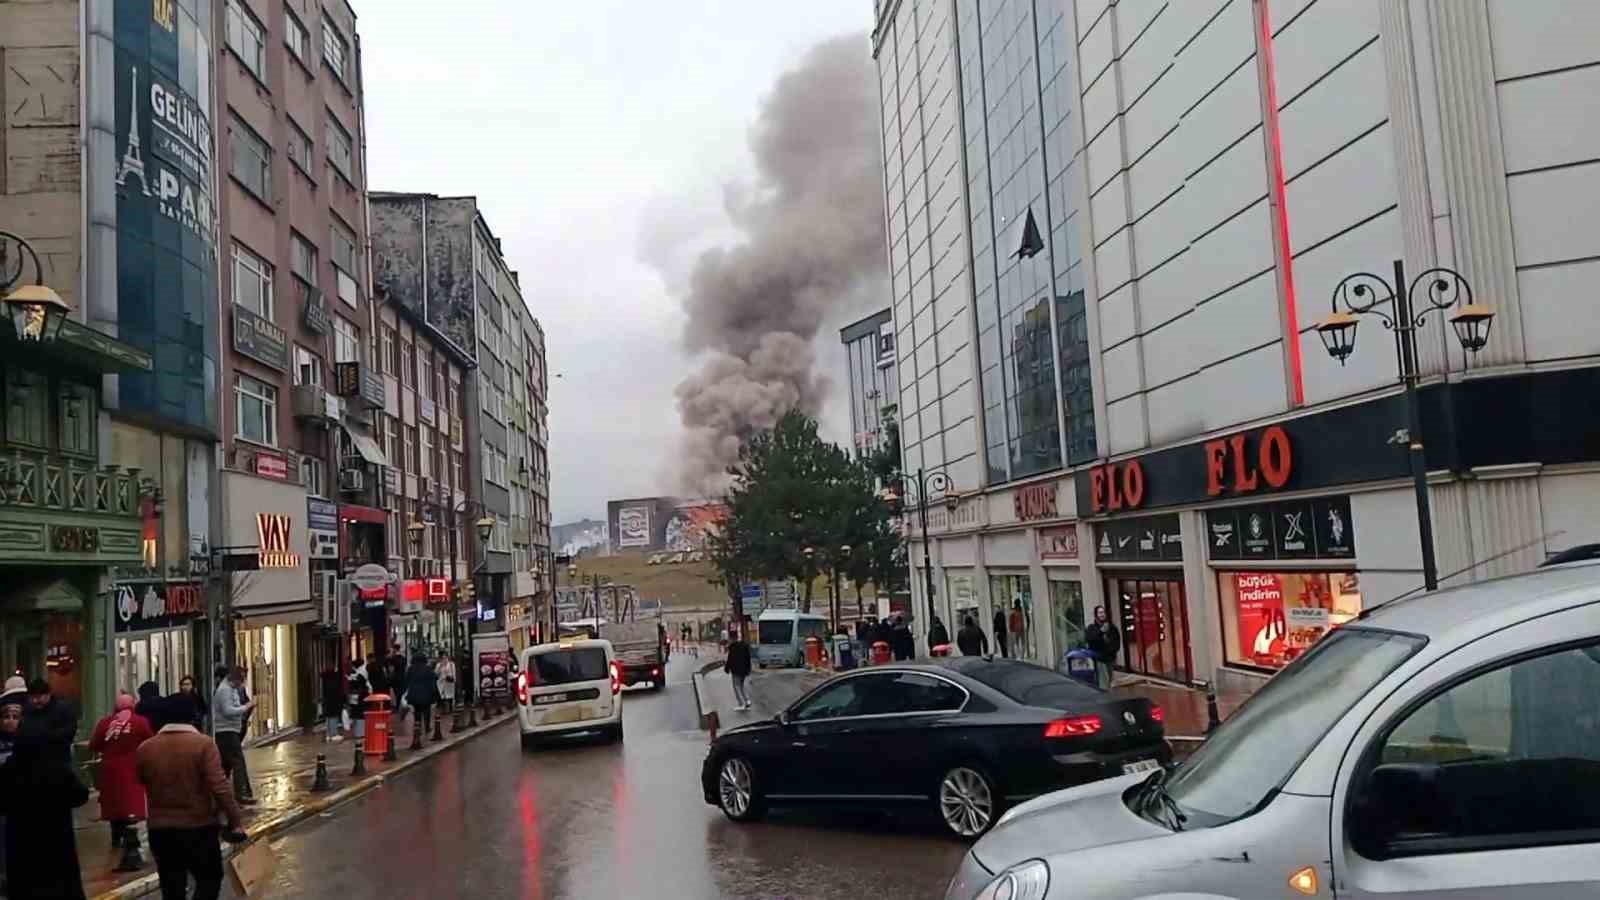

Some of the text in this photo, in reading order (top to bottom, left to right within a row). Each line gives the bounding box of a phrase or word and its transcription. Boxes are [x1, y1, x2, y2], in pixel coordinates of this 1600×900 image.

[1089, 459, 1143, 512] FLO
[1205, 426, 1291, 496] FLO
[1239, 575, 1275, 588] büyük
